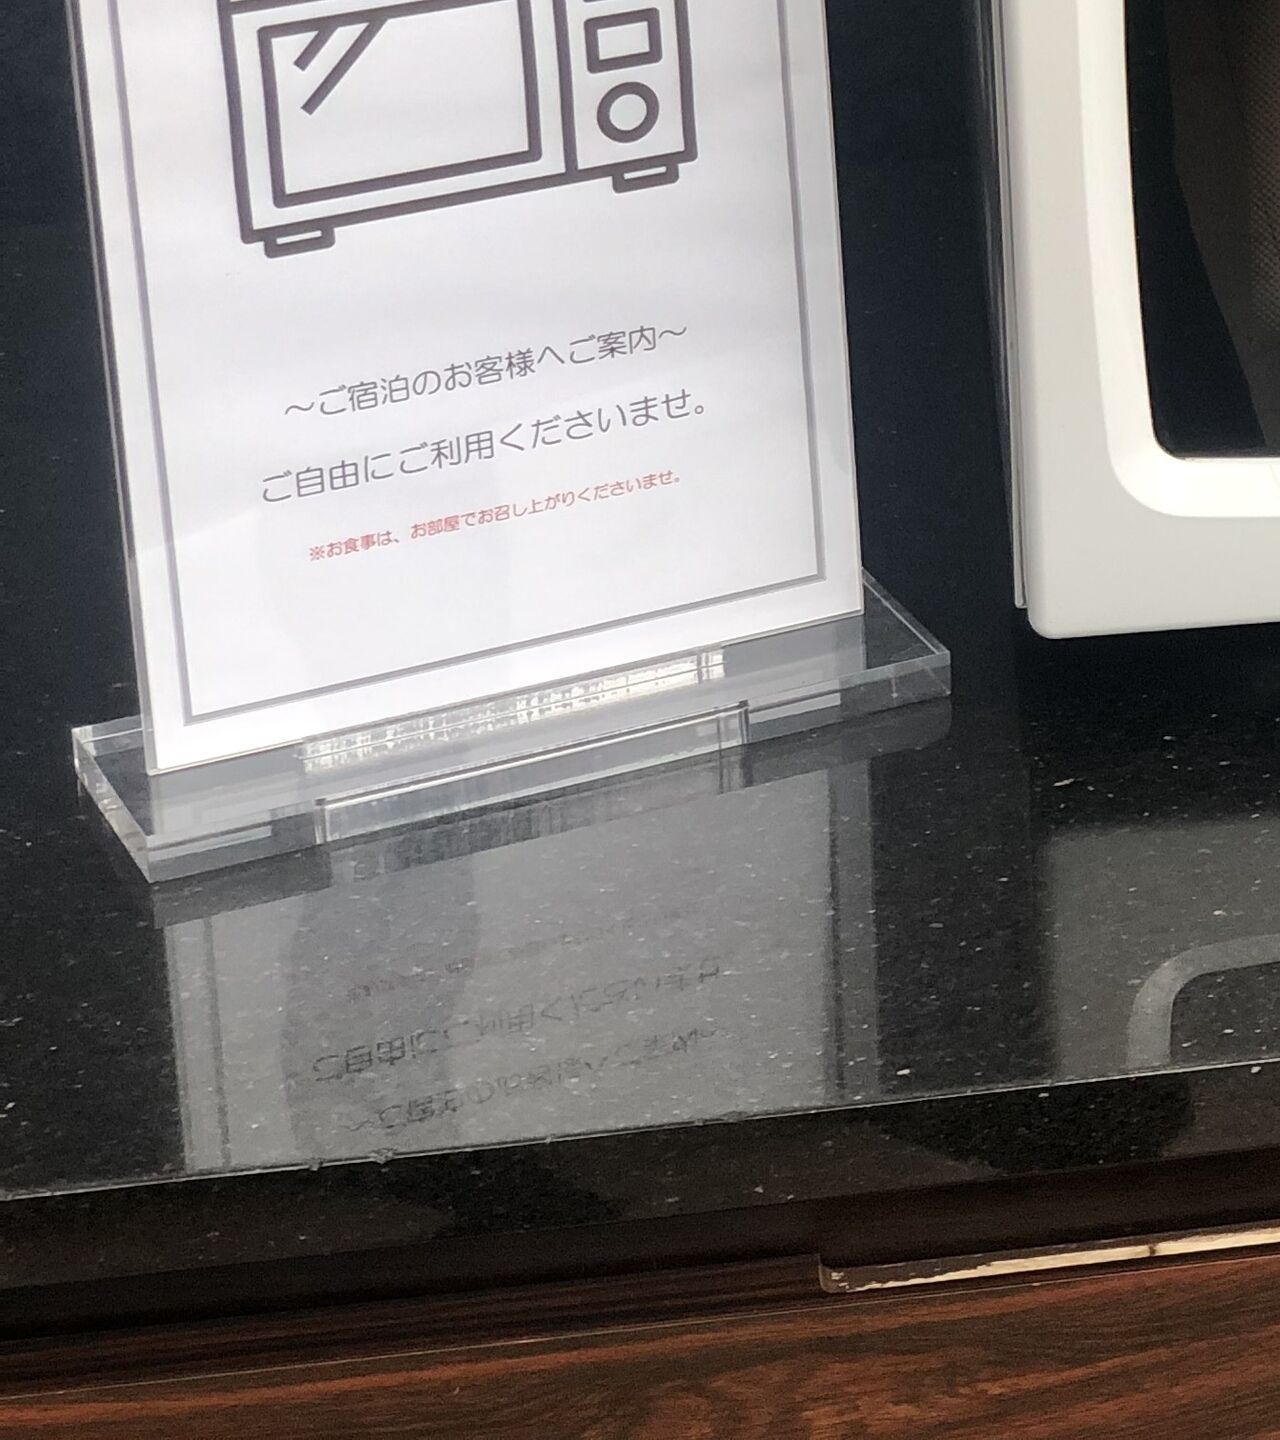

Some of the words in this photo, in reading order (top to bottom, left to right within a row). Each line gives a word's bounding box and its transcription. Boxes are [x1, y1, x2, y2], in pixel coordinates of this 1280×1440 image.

[262, 388, 706, 504] ご自由にご利用くださいませ。
